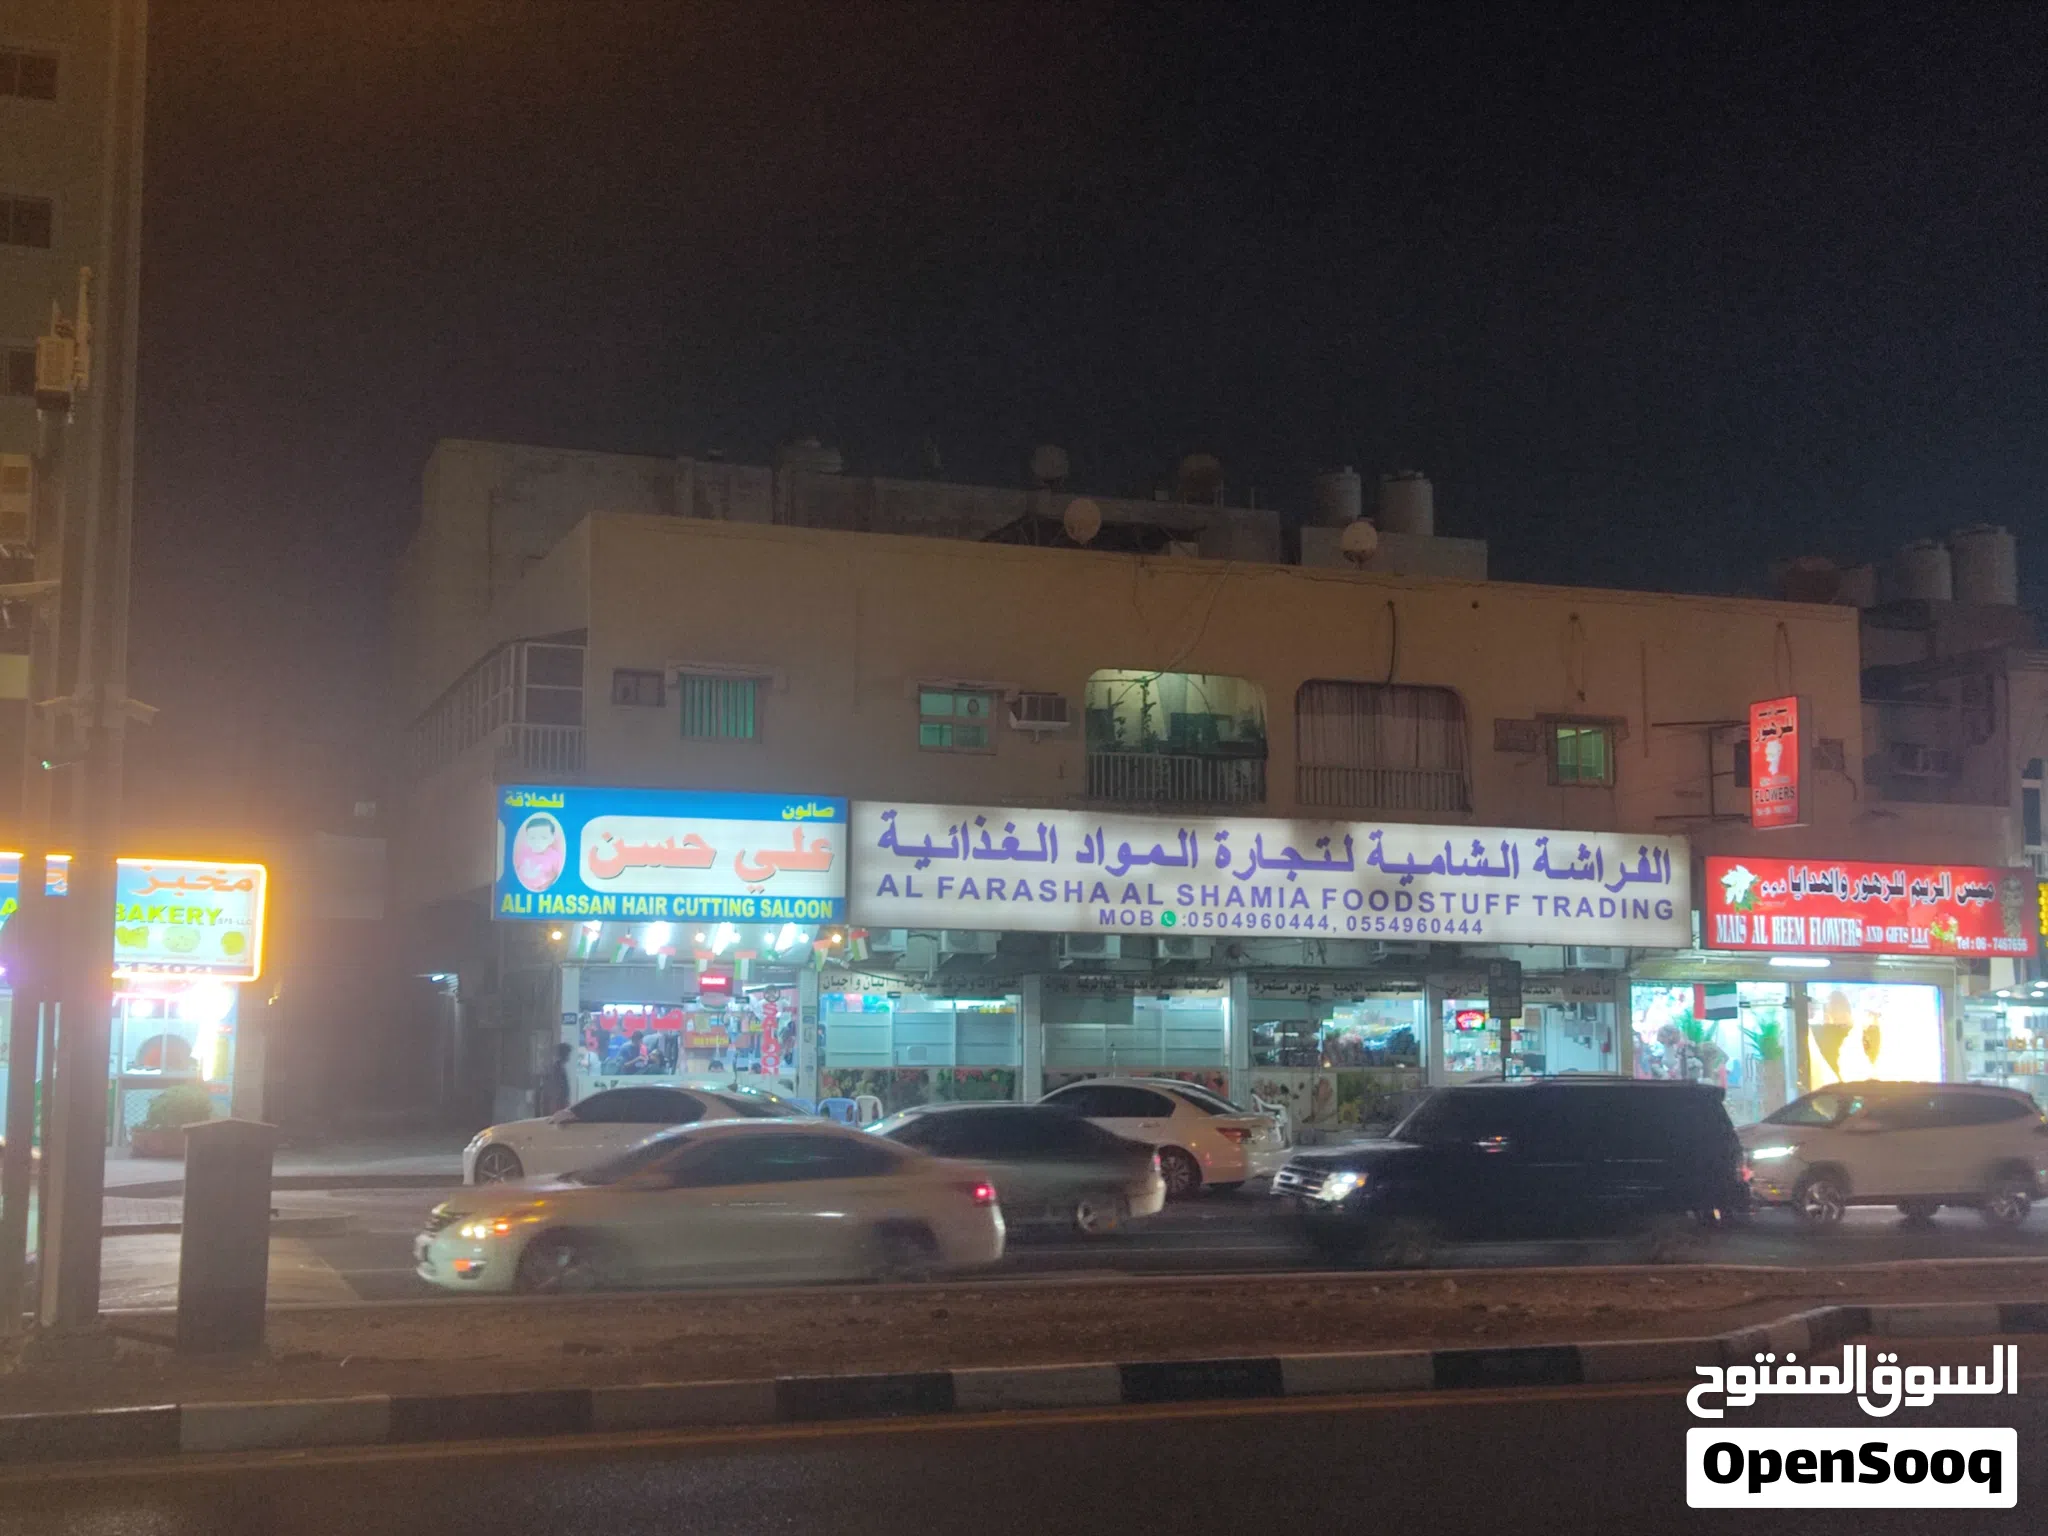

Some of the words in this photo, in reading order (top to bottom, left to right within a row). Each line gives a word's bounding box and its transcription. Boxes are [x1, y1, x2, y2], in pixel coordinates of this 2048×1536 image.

[504, 790, 565, 808] للحلاقة
[782, 802, 835, 819] صالون
[1755, 786, 1795, 802] FLOWERS
[588, 831, 717, 879] حسن
[877, 809, 1059, 871] الغذائية
[1076, 826, 1197, 876] المواد
[1214, 829, 1355, 881] لتجارة
[734, 825, 835, 894] علي
[1366, 829, 1519, 886] الشامية
[1533, 836, 1672, 893] الفراشة
[877, 874, 923, 898] AL
[1176, 884, 1311, 909] SHAMIA
[1321, 888, 1521, 915] FOODSTUFF
[1533, 895, 1673, 920] TRADING
[1789, 866, 1848, 900] والهدايا
[1852, 870, 1906, 902] للزهور
[1909, 871, 1951, 908] الريم
[1955, 880, 1996, 907] ميس
[115, 903, 222, 925] BAKERY
[501, 893, 532, 914] ALI
[538, 894, 616, 916] HASSAN
[622, 896, 667, 916] HAIR
[673, 898, 755, 917] CUTTING
[760, 900, 833, 919] SALOON
[1099, 909, 1154, 927] MOB
[1346, 916, 1483, 935] 0554960444
[1716, 914, 1747, 944] MAIS
[1752, 915, 1768, 944] AL
[1772, 915, 1805, 945] REEM
[1809, 917, 1863, 947] FLOWERS
[1866, 926, 1882, 943] AND
[1886, 926, 1909, 943] GIFTS
